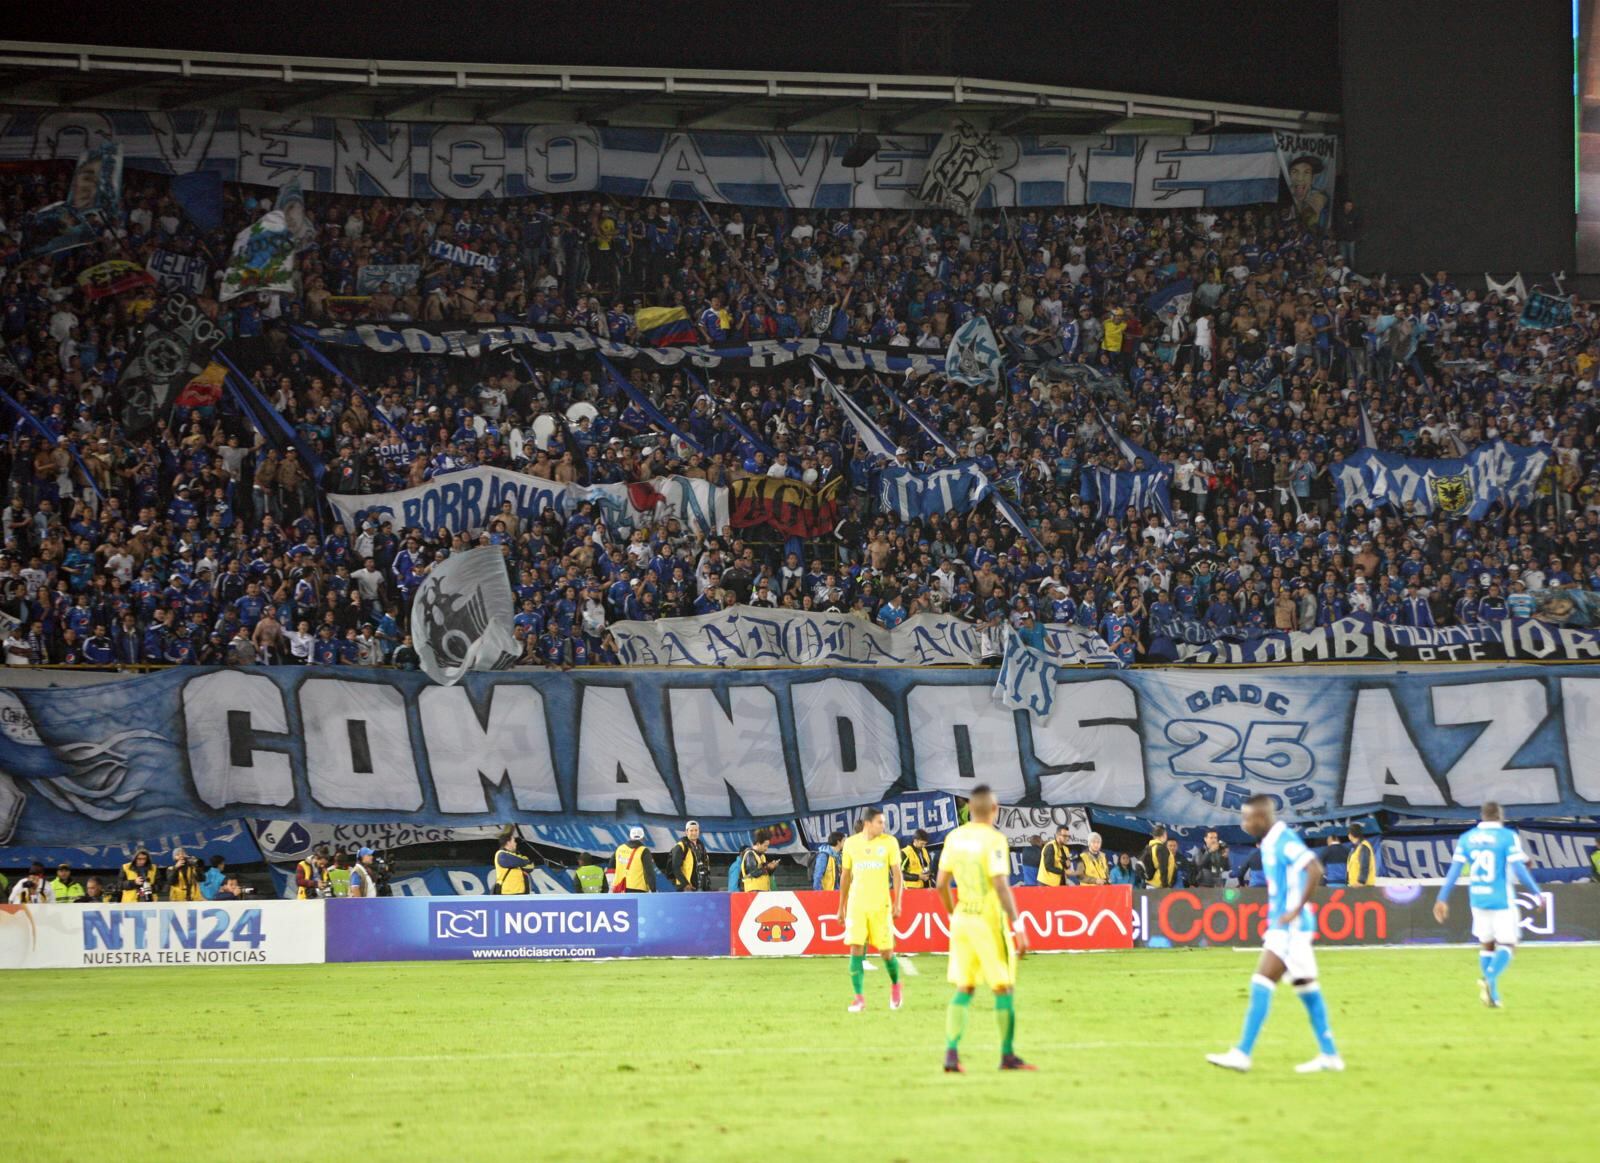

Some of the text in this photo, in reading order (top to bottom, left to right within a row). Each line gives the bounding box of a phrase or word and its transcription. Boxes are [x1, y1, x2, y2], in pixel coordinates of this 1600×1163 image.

[144, 110, 600, 199] VENGO
[645, 132, 733, 204] A
[182, 669, 1147, 814] COMANDOS
[1164, 718, 1316, 783] 25
[1470, 851, 1496, 882] 29
[82, 909, 266, 950] NTN24
[505, 910, 630, 934] NOTICIAS
[83, 951, 266, 965] NUESTRA TELE NOTICIAS
[472, 946, 596, 958] www.noticiasrcn.com
